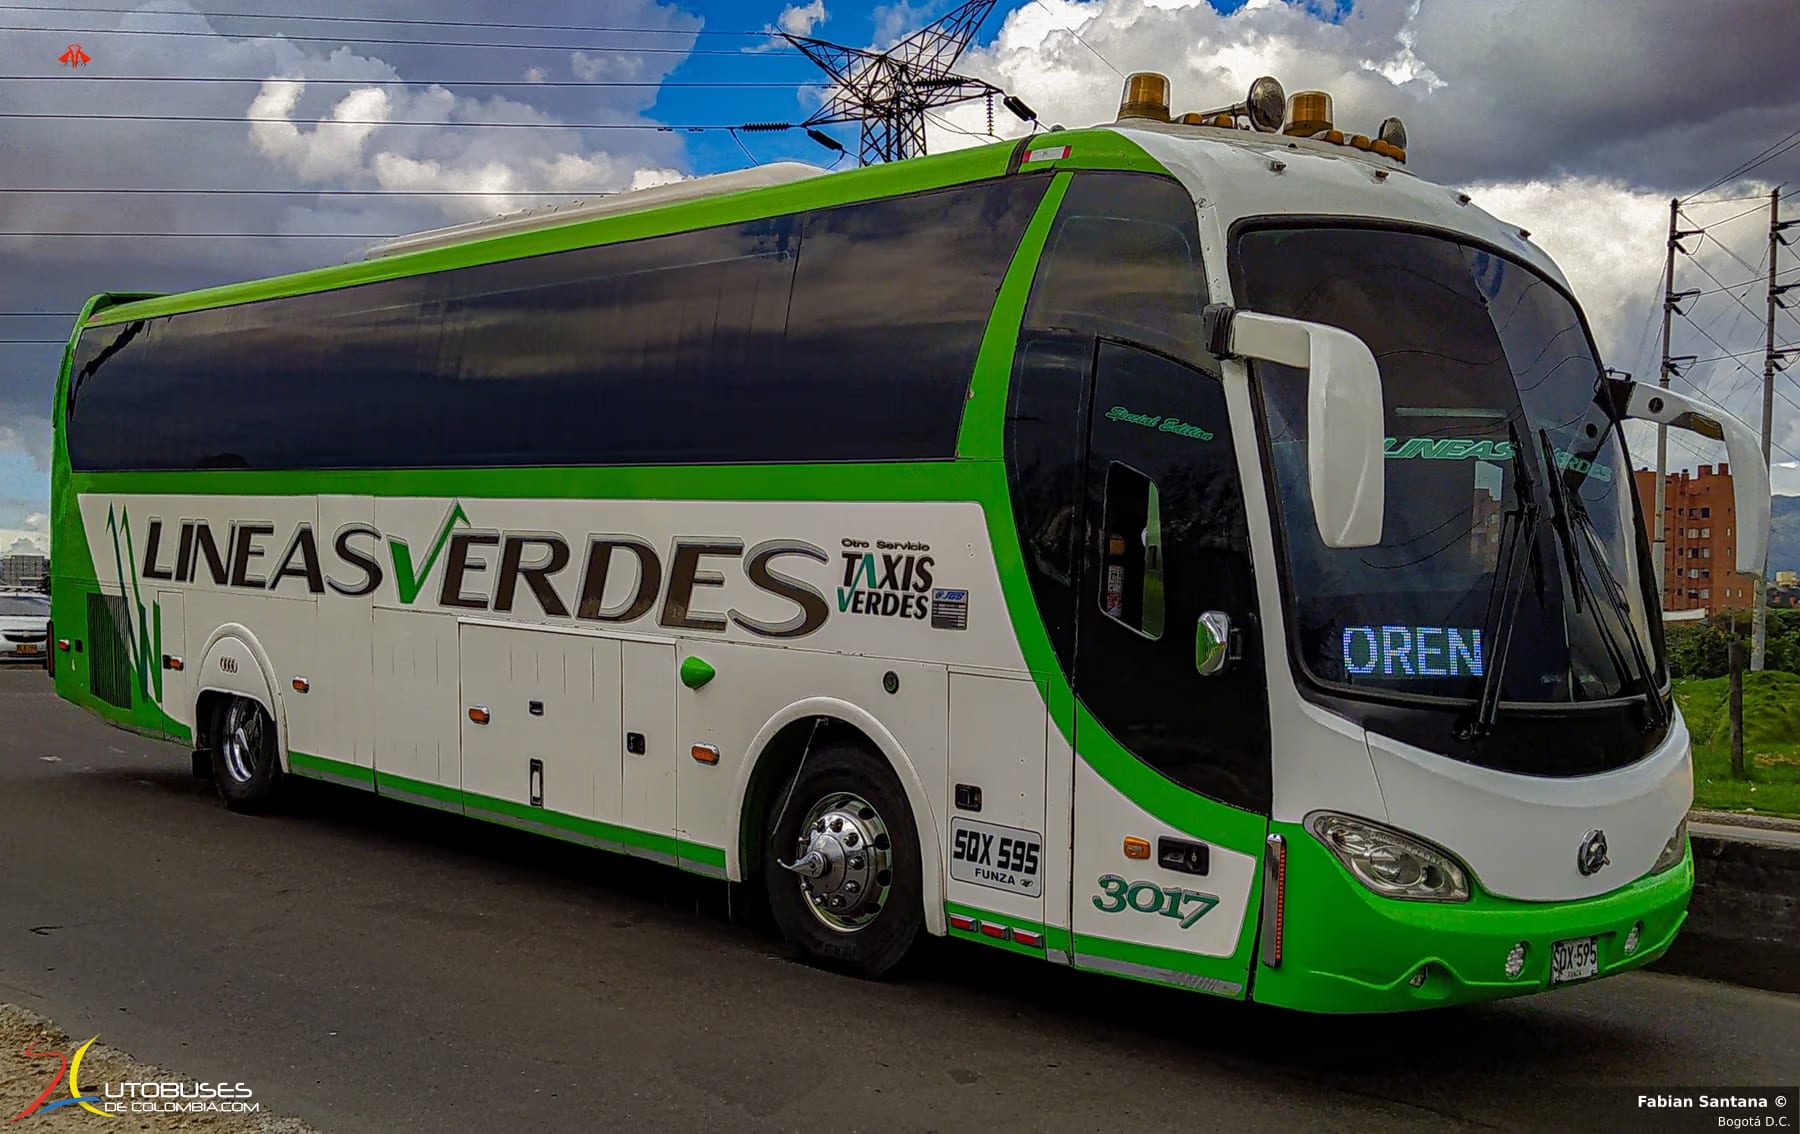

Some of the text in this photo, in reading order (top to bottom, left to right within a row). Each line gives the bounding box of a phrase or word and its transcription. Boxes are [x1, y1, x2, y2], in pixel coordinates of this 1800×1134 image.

[841, 538, 931, 552] Otro Servicio
[841, 551, 935, 593] TAXIS
[837, 586, 929, 620] VERDES
[1343, 625, 1484, 677] OREN
[975, 867, 1016, 885] FUNZA
[997, 837, 1040, 876] 595
[1091, 874, 1221, 930] 3017
